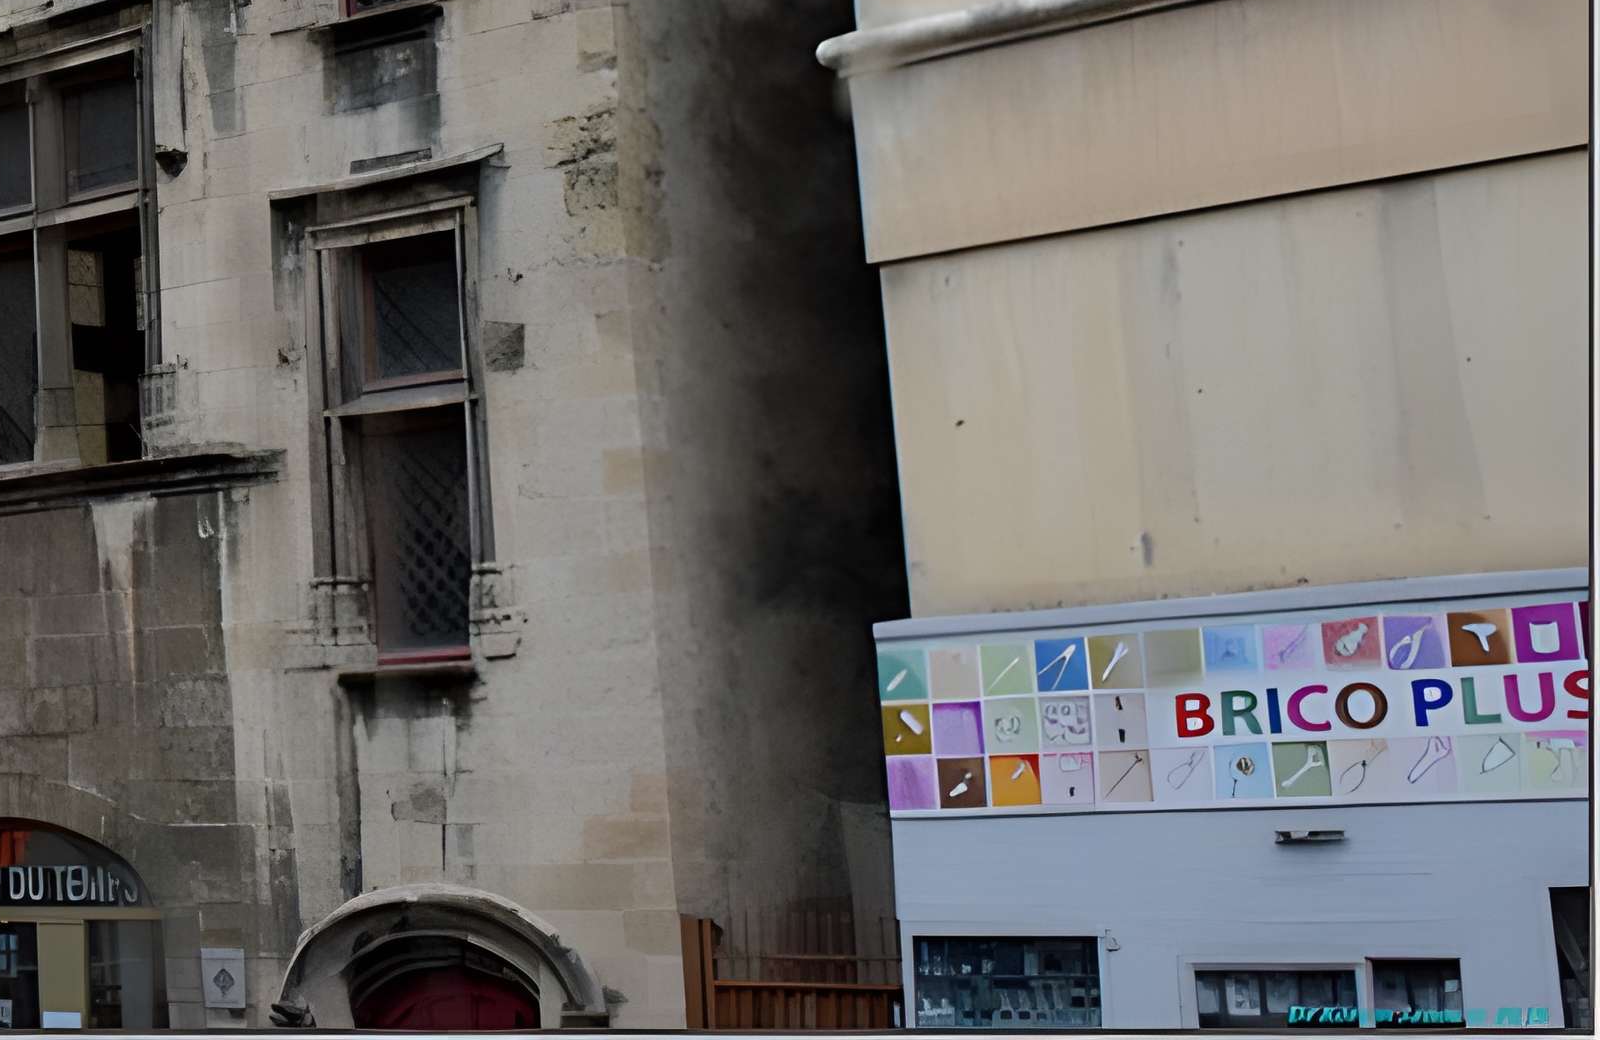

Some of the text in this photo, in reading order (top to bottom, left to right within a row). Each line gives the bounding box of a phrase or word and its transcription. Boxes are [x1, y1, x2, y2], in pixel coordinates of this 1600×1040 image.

[1174, 669, 1590, 738] BRICO PLUS
[8, 865, 44, 901] DU
